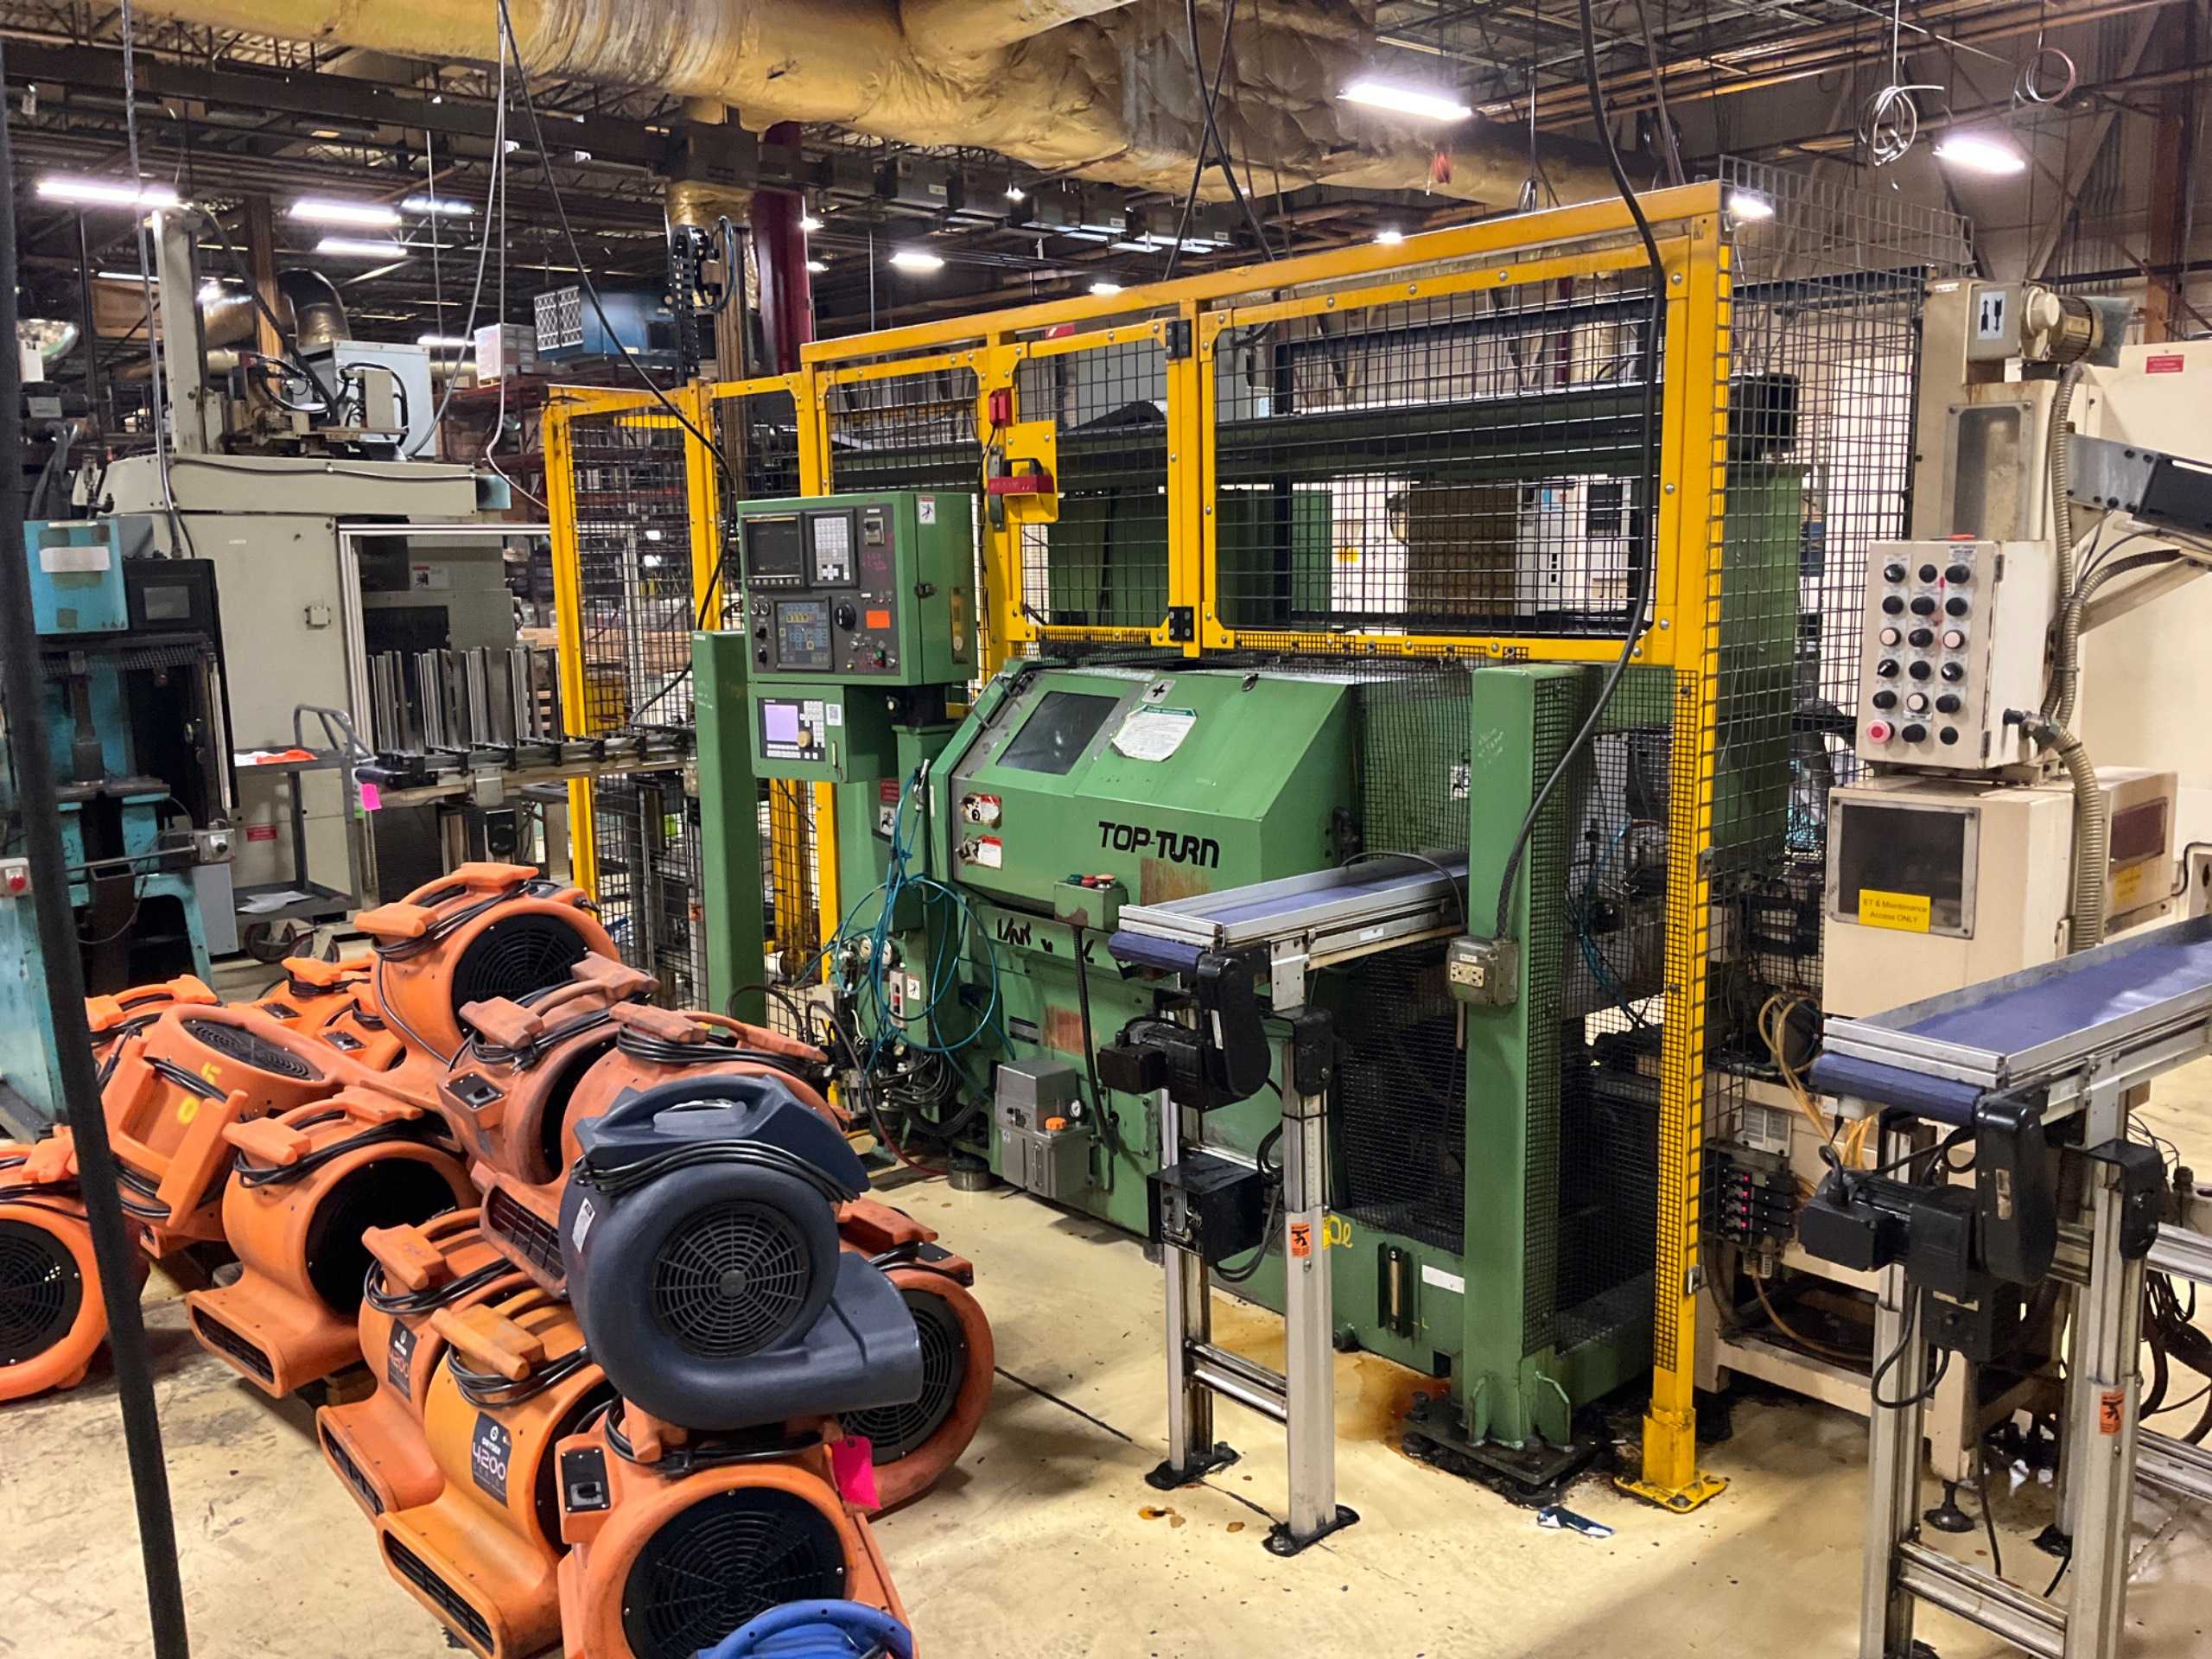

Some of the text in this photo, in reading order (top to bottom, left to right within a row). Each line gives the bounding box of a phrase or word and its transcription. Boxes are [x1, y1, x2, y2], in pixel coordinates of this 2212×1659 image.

[1098, 820, 1220, 869] TOP-TURN
[1870, 911, 1917, 924] Access ONLY
[1883, 900, 1928, 912] Maintenance
[472, 1441, 506, 1481] 4200
